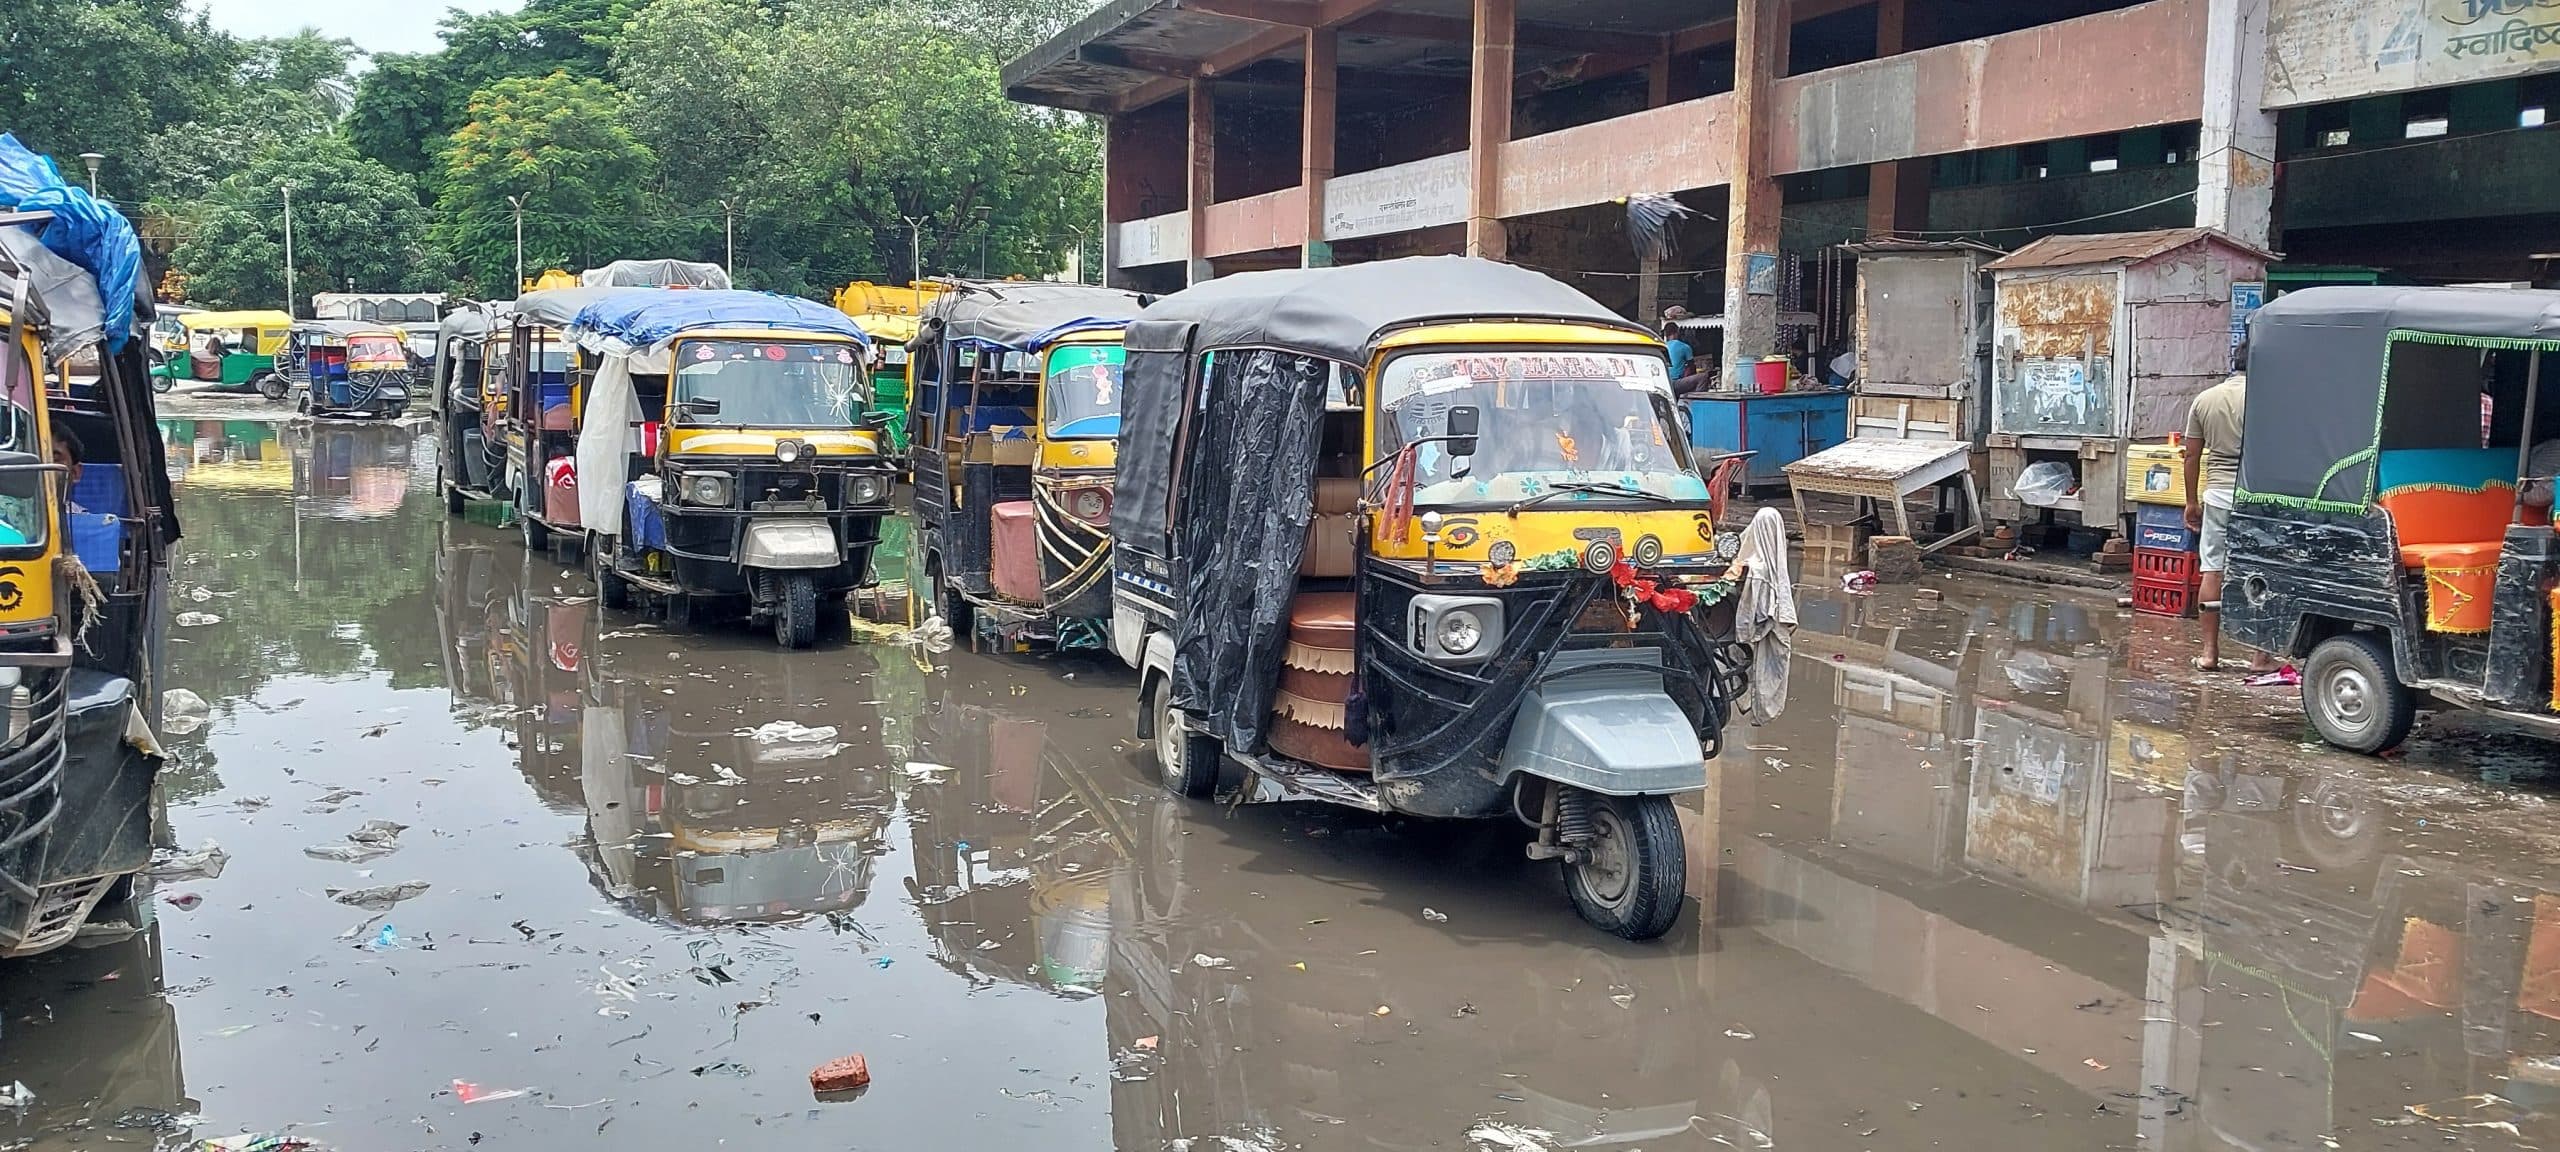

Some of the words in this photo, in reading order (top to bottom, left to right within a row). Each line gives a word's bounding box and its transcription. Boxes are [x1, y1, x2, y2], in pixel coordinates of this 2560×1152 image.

[1452, 357, 1509, 379] JAY
[1519, 357, 1605, 378] MATA
[1608, 358, 1639, 377] DI
[2152, 533, 2181, 543] PEPSI
